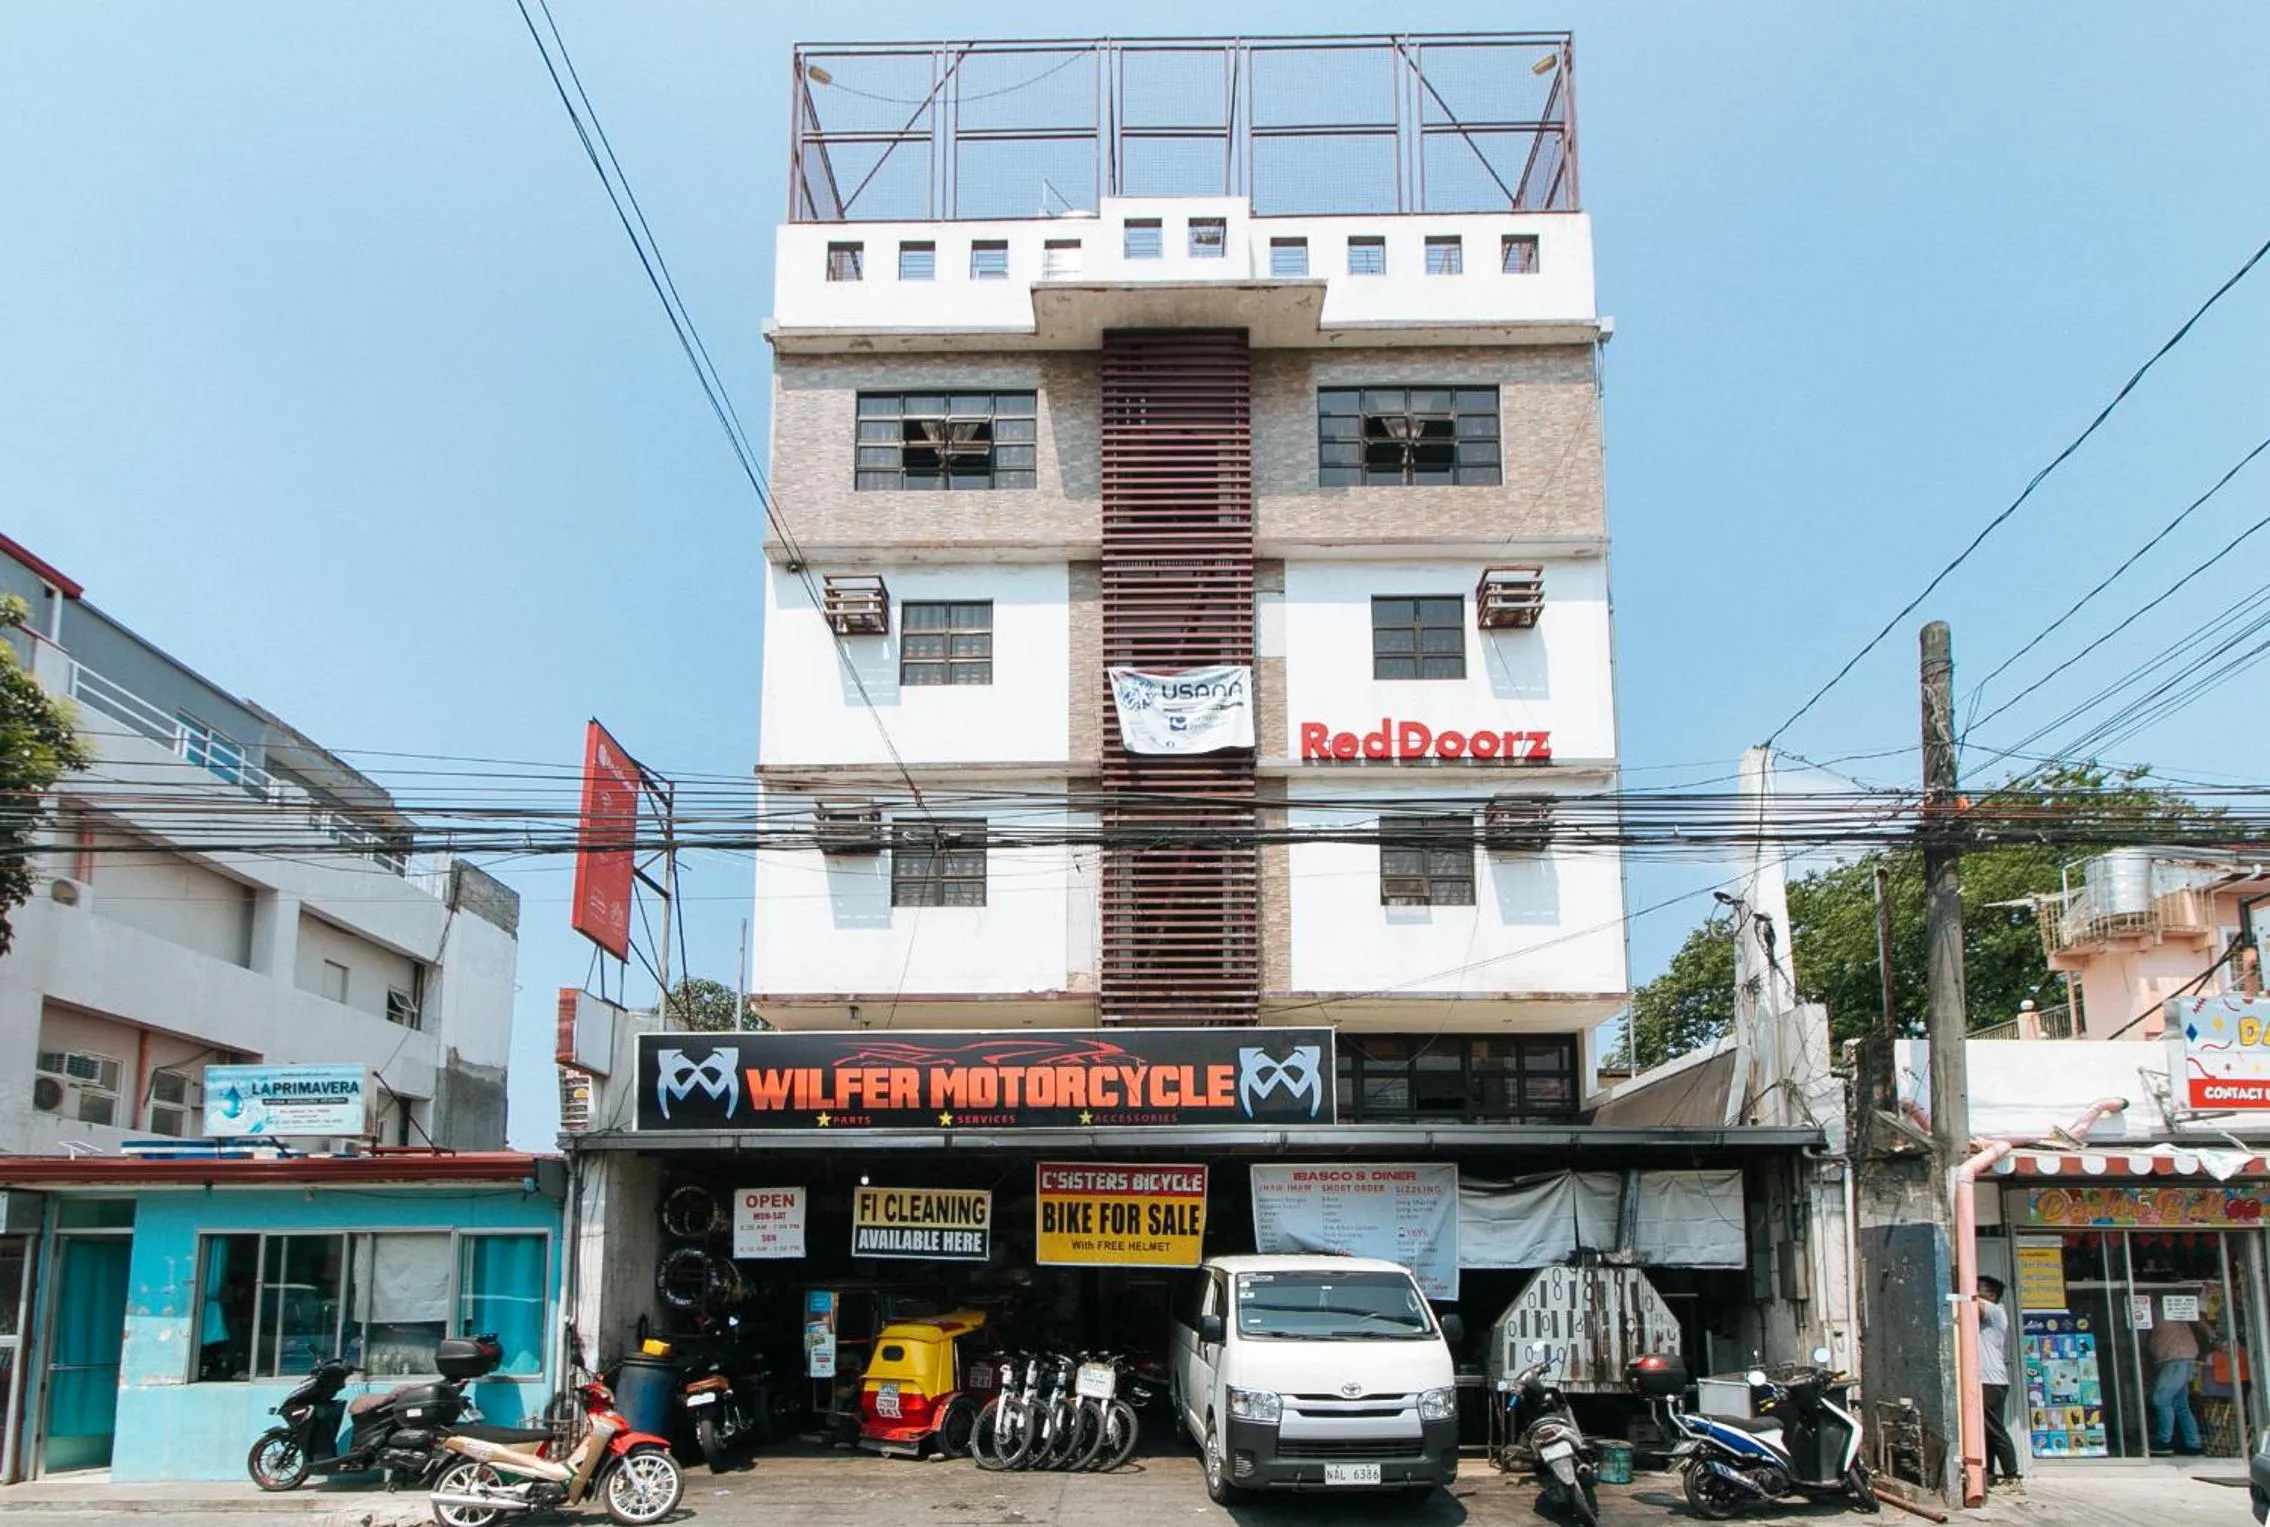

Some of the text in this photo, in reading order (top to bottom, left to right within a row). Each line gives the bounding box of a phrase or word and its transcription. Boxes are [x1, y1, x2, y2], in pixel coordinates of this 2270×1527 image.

[1162, 681, 1243, 699] USANA
[1301, 718, 1552, 759] RedDoorz
[746, 1065, 1235, 1110] WILFER MOTORCYCLE
[2204, 1086, 2262, 1100] CONTACT
[833, 1116, 871, 1125] PARTS
[957, 1115, 1017, 1124] SERVICES
[1095, 1113, 1178, 1124] ACCESSORIES
[1372, 1171, 1416, 1181] DINER
[1322, 1184, 1384, 1192] SHORT ORDER
[1395, 1185, 1441, 1193] SIZZLING
[746, 1194, 795, 1208] OPEN
[861, 1194, 986, 1225] FI CLEANING
[1042, 1202, 1199, 1235] BIKE FOR SALE
[858, 1228, 982, 1252] AVAILABLE HERE
[1071, 1240, 1171, 1252] With FREE HELMET
[1326, 1469, 1346, 1481] NAL
